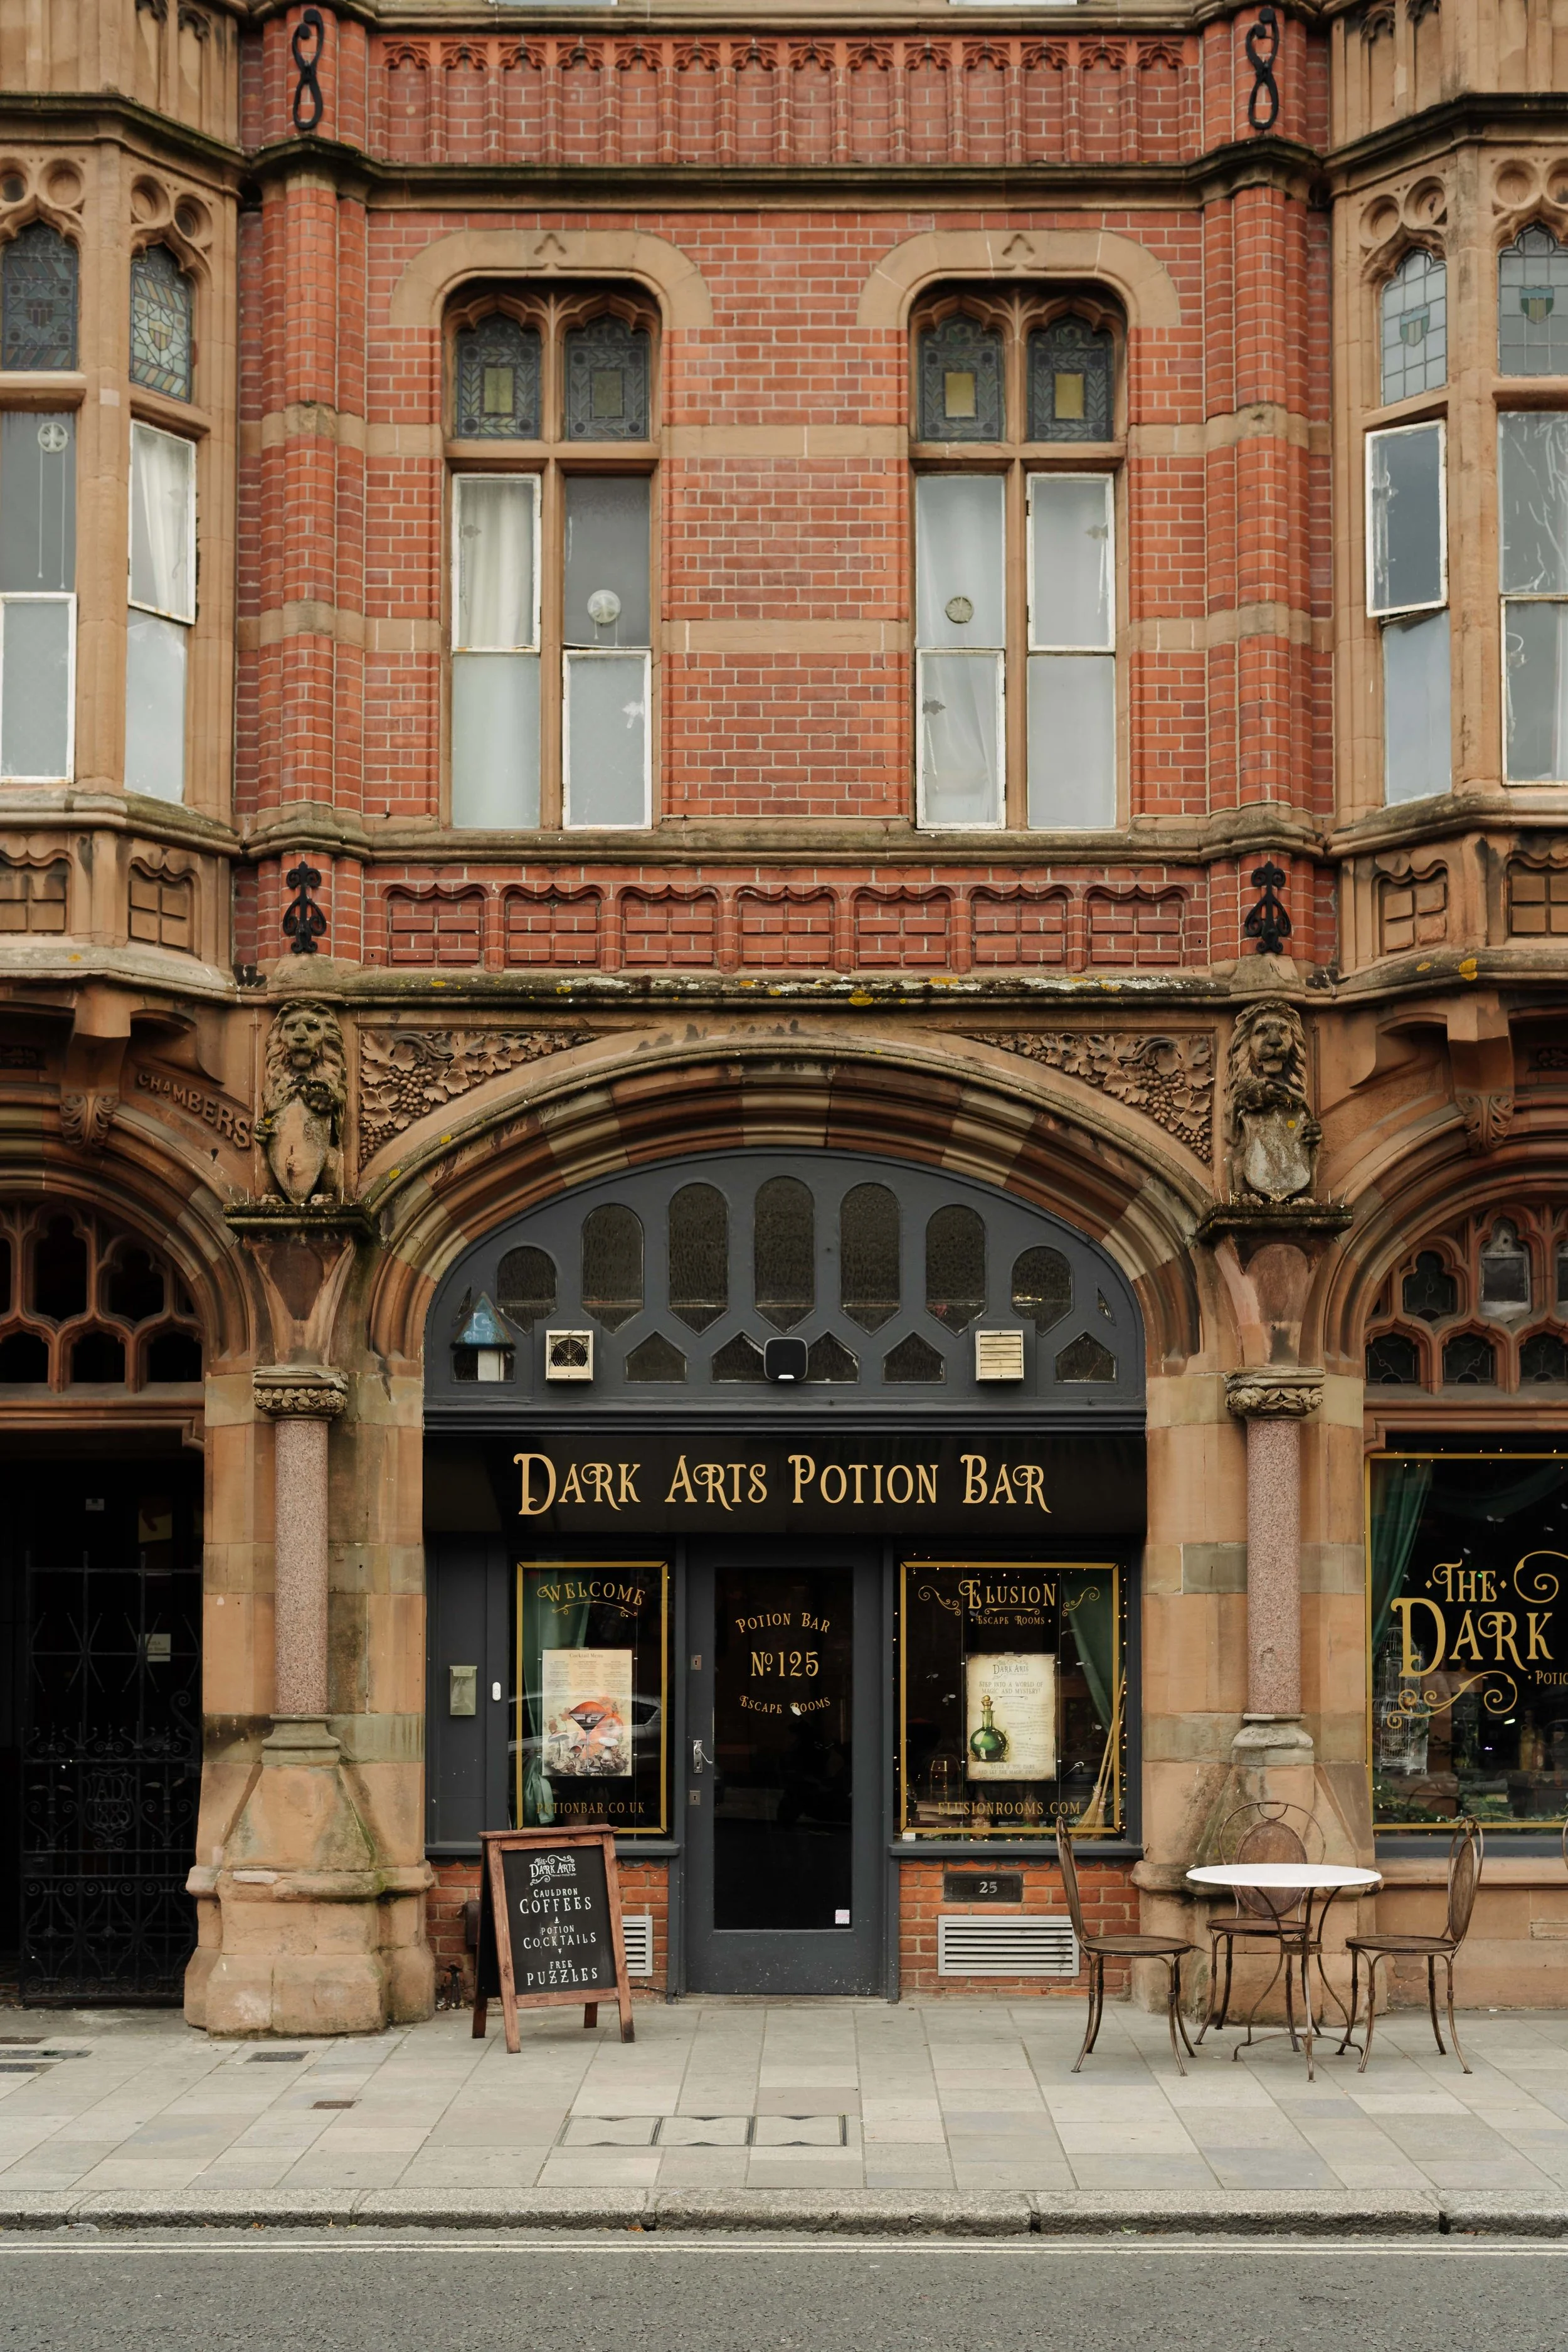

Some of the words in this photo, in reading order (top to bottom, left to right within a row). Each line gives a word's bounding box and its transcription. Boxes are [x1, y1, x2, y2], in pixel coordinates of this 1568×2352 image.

[138, 1073, 252, 1148] CHAMBERS
[513, 1453, 641, 1515] DARK
[664, 1454, 768, 1511] ARTS
[788, 1454, 939, 1504] POTION
[960, 1454, 1052, 1513] BAR
[1432, 1558, 1498, 1602] THE
[537, 1581, 645, 1606] WELCOME
[958, 1579, 1057, 1609] ELUSION
[735, 1613, 791, 1633] POTION
[801, 1612, 830, 1633] BAR
[976, 1615, 1009, 1624] ESCAPE
[1014, 1615, 1045, 1626] ROOMS
[1390, 1597, 1555, 1678] DARK
[778, 1651, 819, 1677] 125
[992, 1664, 1012, 1675] DARK
[739, 1695, 782, 1714] ESCAPE
[537, 1802, 645, 1814] POTIONBAR.CO.UK
[938, 1801, 1081, 1815] ELUSIONROOMS.COM
[529, 1863, 555, 1878] DARK
[557, 1862, 576, 1874] ARTS
[533, 1887, 578, 1899] CAULDRON
[978, 1881, 999, 1894] 25
[519, 1897, 592, 1914] COFFEES
[541, 1924, 575, 1936] POTION
[523, 1932, 596, 1949] COCKTAILS
[549, 1959, 573, 1969] FREE
[527, 1967, 598, 1986] PUZZLES
